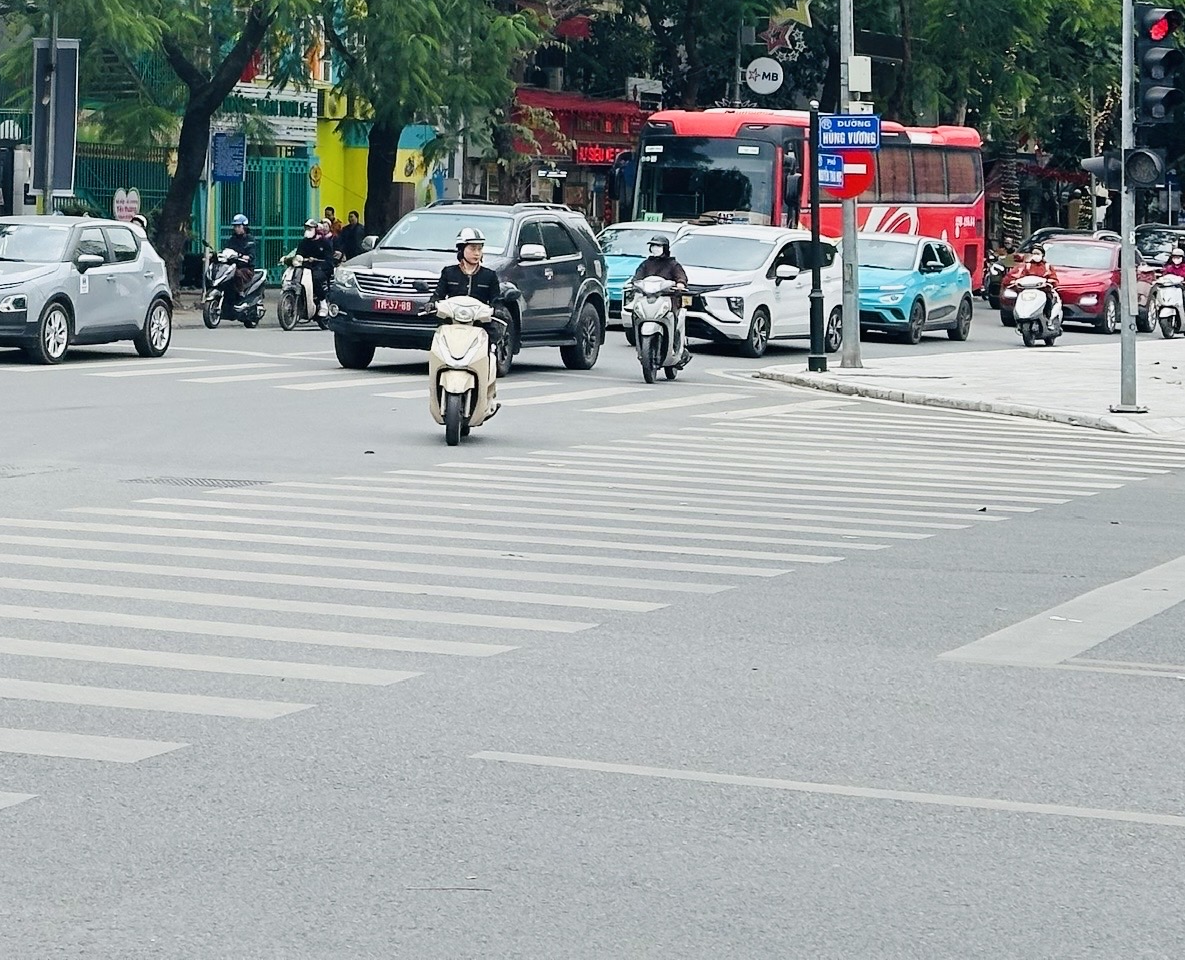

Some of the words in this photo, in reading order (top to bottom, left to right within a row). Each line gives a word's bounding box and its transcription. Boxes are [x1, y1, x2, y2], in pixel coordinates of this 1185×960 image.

[761, 71, 779, 82] MB
[823, 130, 845, 144] HÙNG
[848, 130, 876, 144] VƯƠNG
